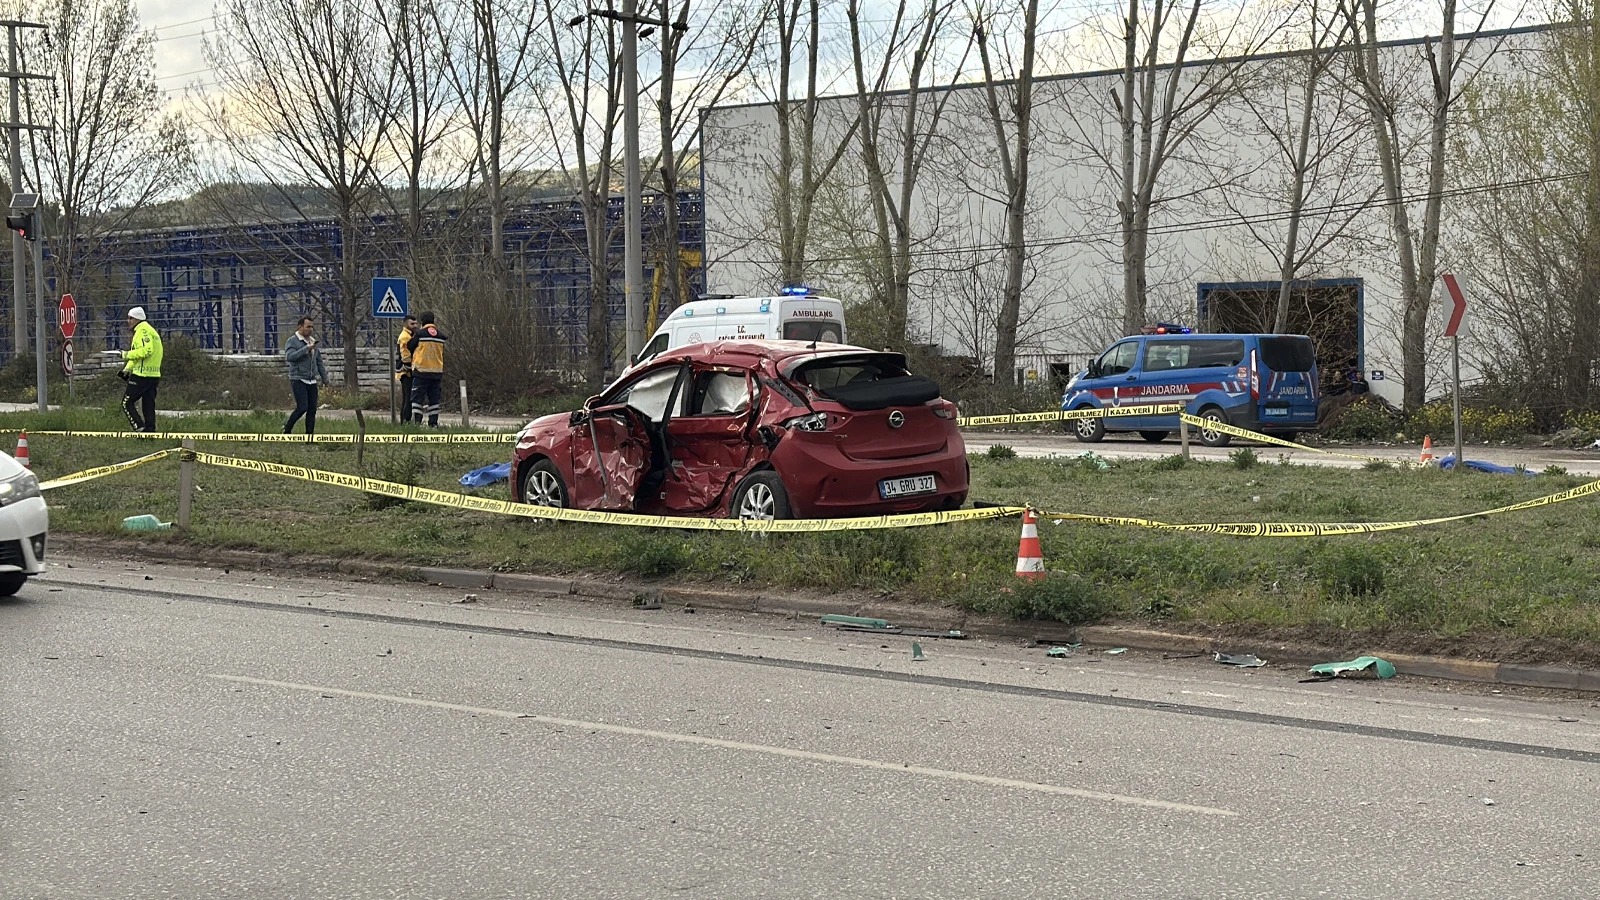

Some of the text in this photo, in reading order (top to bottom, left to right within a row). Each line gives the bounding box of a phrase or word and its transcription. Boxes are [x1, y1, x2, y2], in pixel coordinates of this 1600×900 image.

[60, 307, 76, 325] DUR
[792, 310, 833, 318] AMBULANS
[1141, 384, 1190, 395] JANDARMA
[1279, 386, 1307, 395] JANDARMA
[973, 417, 1008, 425] GİRİLMEZ
[1015, 413, 1038, 422] KAZA
[1038, 412, 1057, 421] YERİ
[1067, 410, 1102, 419] GİRİLMEZ
[1110, 407, 1132, 416] KAZA
[1132, 406, 1151, 415] YERİ
[885, 476, 933, 494] 34 GRU 327
[1289, 523, 1315, 532] KAZA
